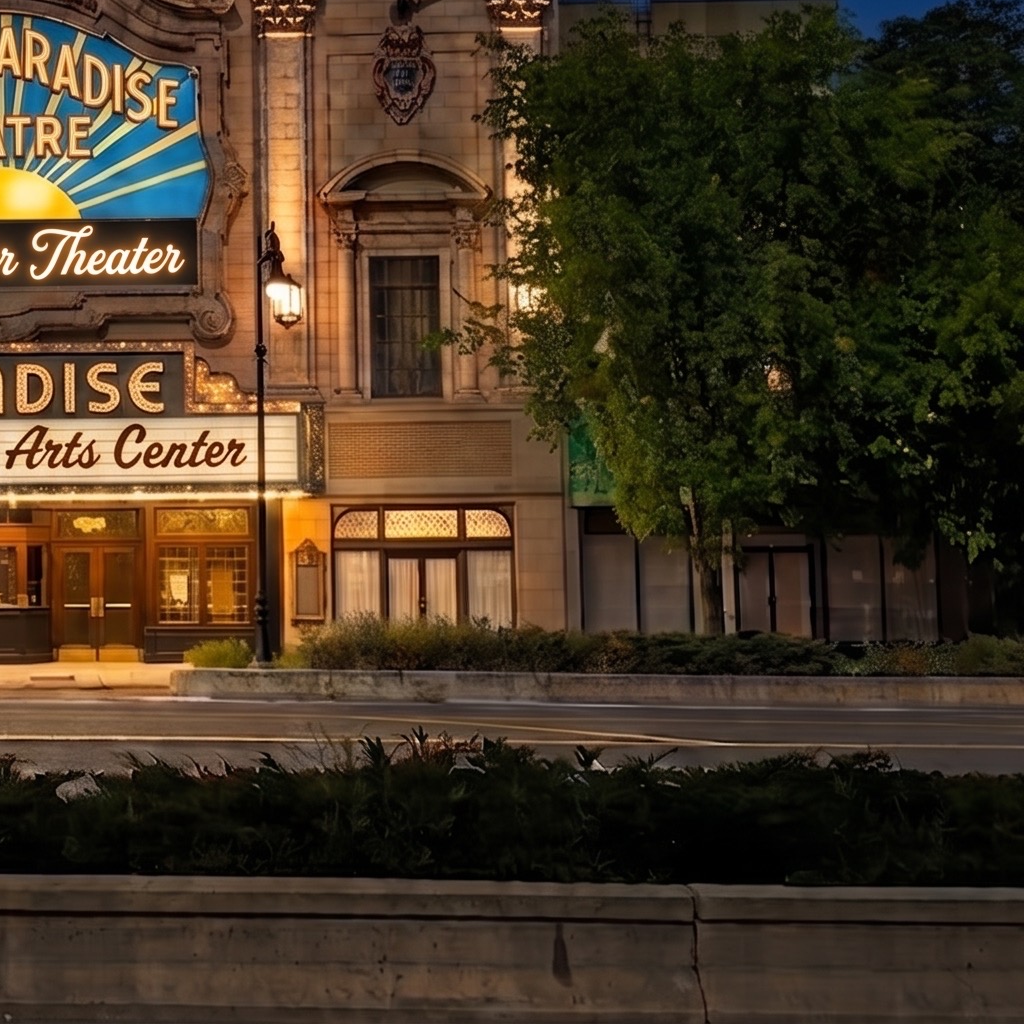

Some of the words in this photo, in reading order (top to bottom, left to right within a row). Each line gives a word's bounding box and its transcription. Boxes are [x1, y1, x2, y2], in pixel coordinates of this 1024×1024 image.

[30, 226, 186, 280] Theater
[4, 424, 100, 470] Arts
[114, 423, 247, 470] Center
